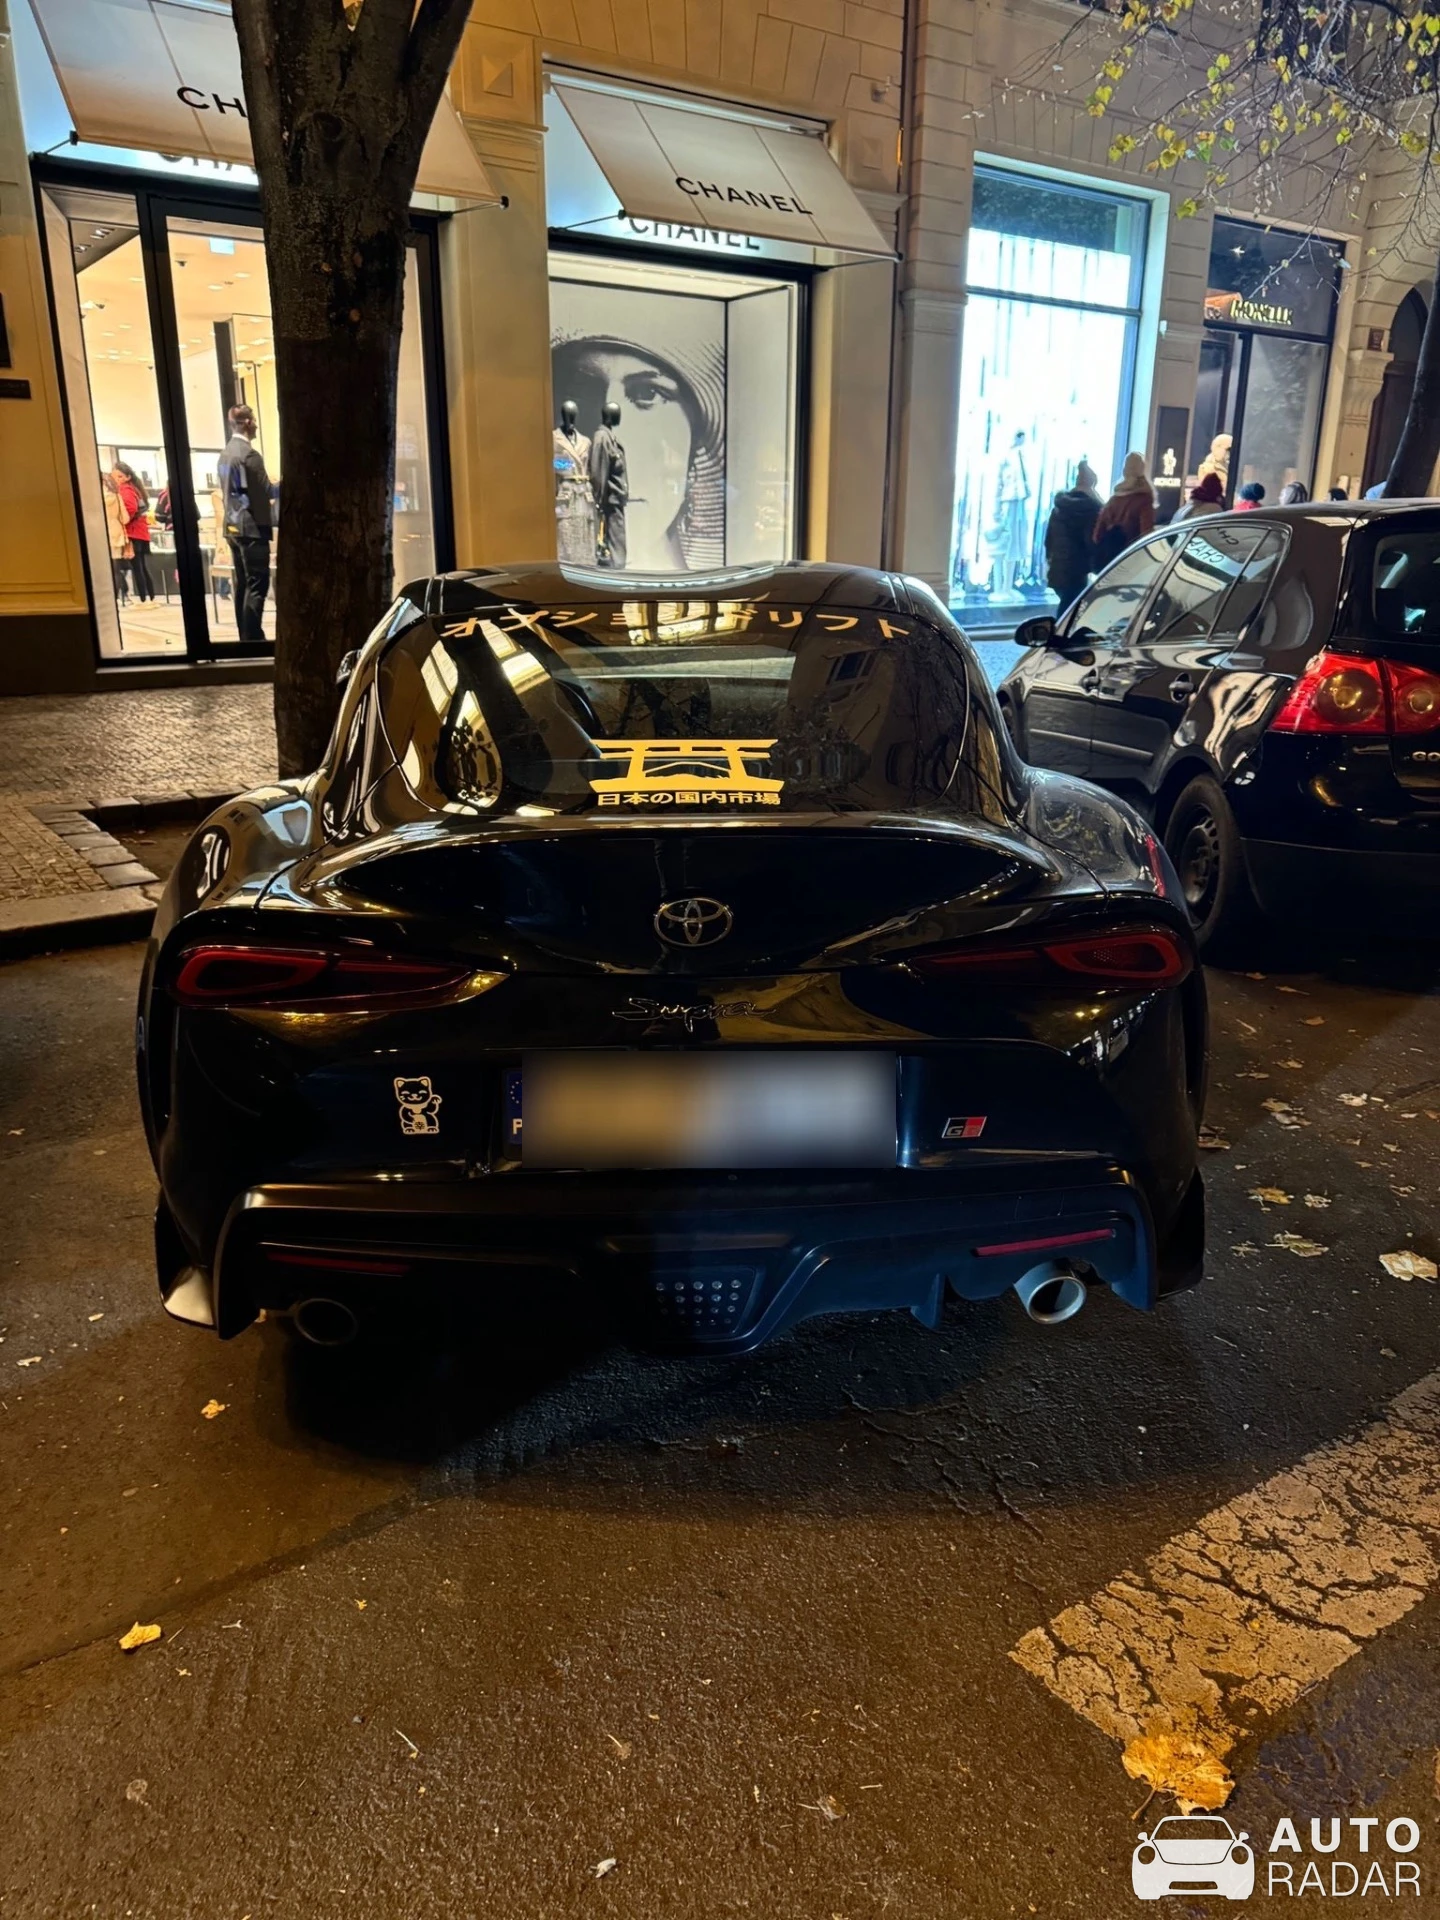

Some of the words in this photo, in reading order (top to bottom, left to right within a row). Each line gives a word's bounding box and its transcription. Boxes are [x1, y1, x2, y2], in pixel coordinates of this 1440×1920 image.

[675, 177, 813, 215] CHANEL
[597, 792, 781, 806] 日本の国内市場
[612, 998, 777, 1033] Supra
